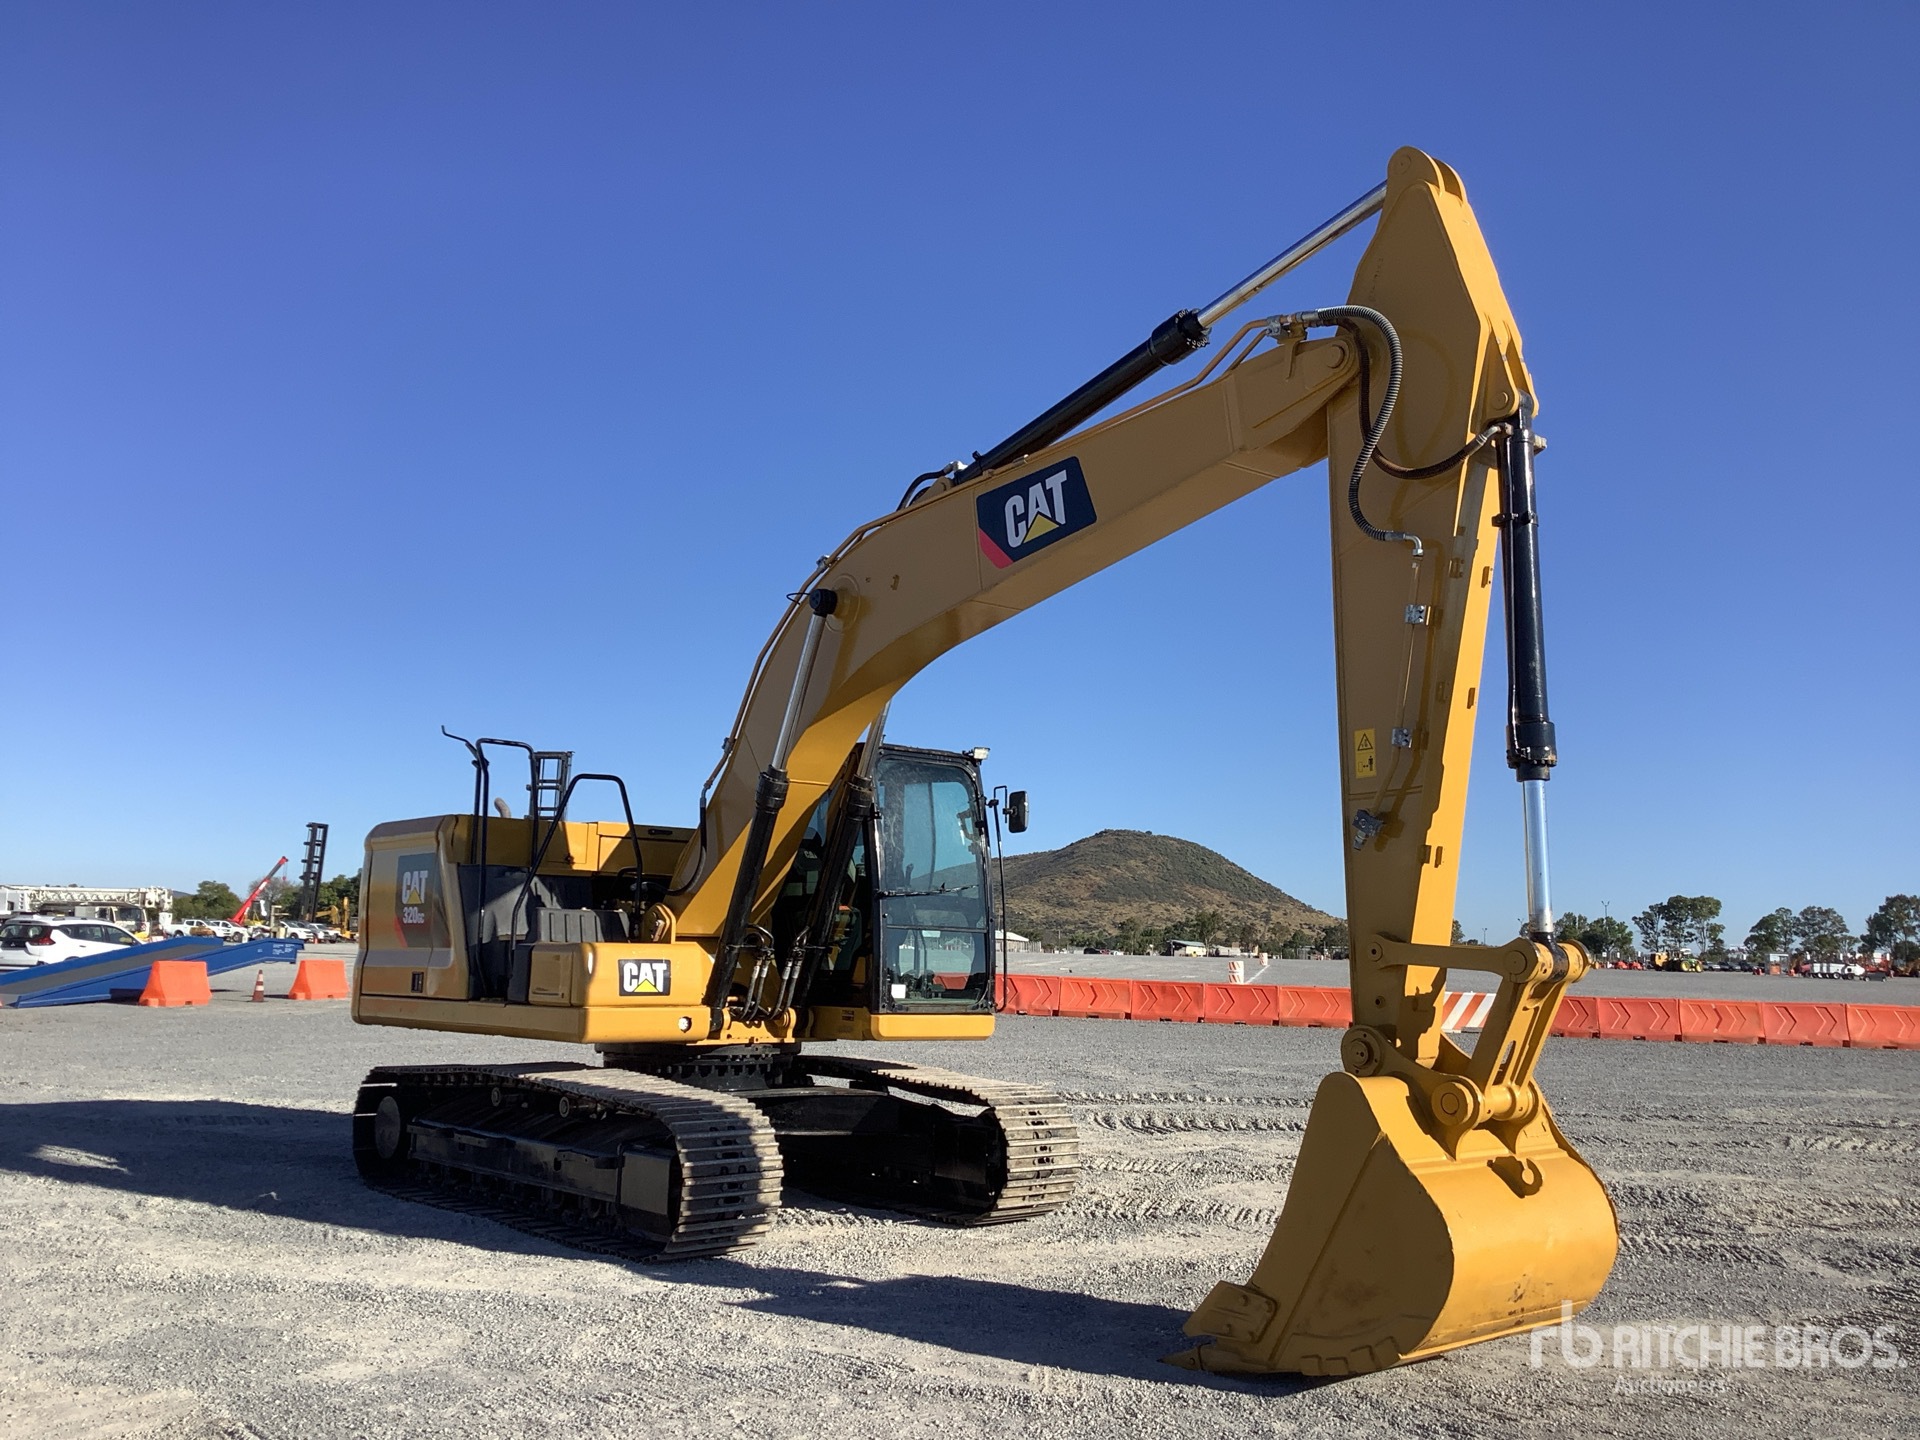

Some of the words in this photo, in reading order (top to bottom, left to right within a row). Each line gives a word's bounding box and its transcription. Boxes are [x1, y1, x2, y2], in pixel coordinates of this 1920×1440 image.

[1004, 469, 1067, 548] CAT
[402, 870, 428, 904] CAT
[623, 962, 667, 992] CAT
